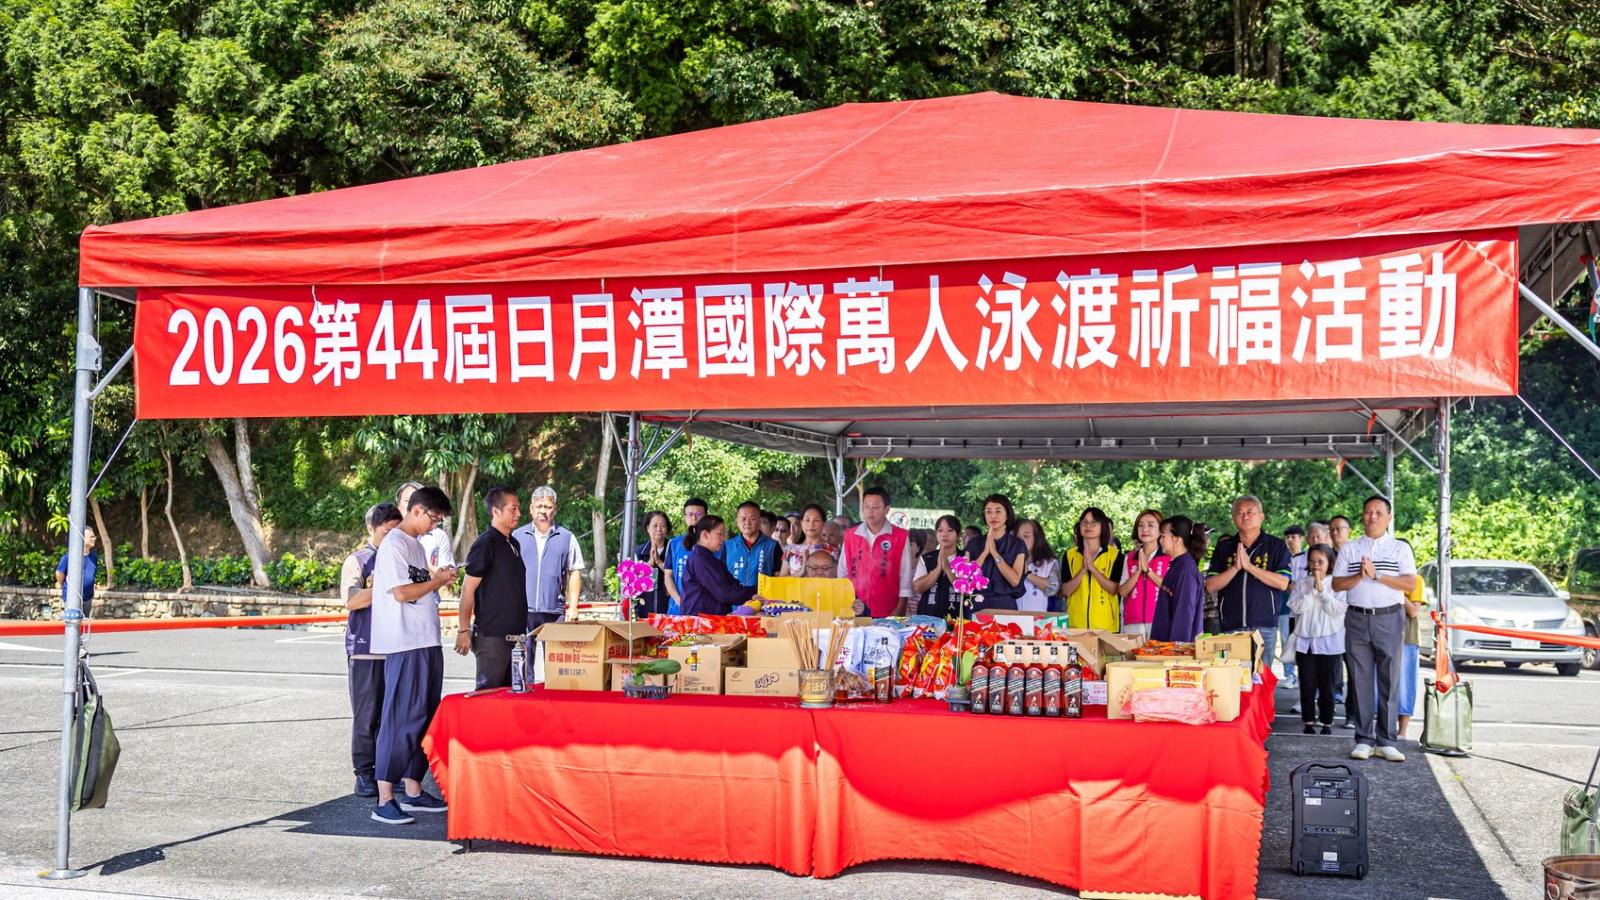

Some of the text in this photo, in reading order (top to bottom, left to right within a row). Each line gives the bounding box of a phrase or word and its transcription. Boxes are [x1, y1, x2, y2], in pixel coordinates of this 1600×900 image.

[167, 252, 1457, 387] 2026第44屆日月潭國際萬人泳渡祈福活動
